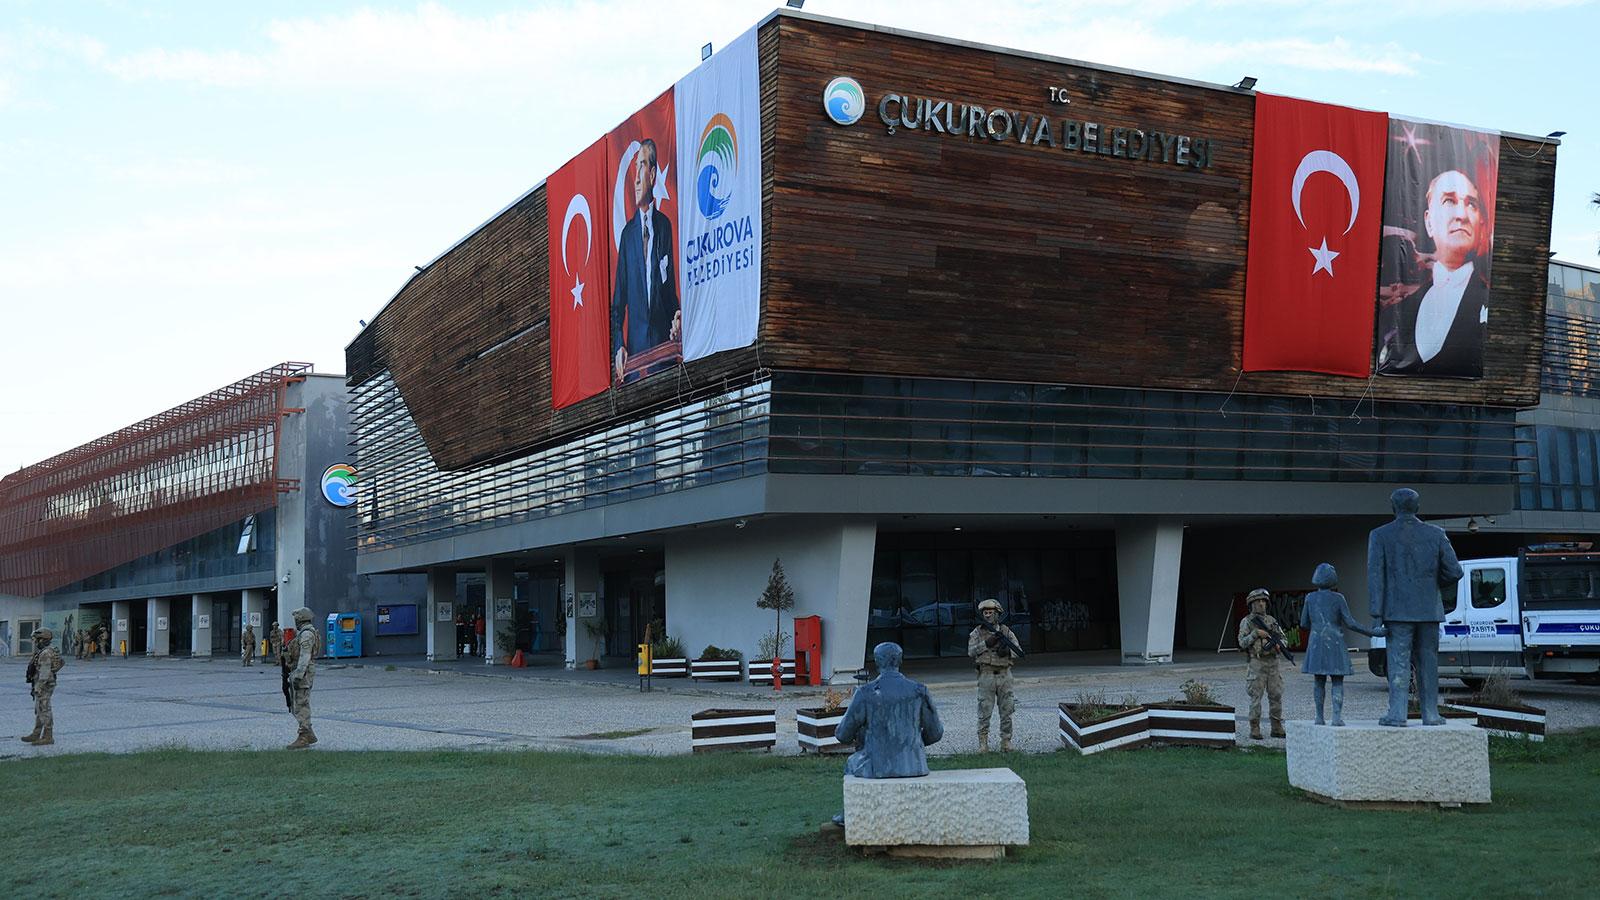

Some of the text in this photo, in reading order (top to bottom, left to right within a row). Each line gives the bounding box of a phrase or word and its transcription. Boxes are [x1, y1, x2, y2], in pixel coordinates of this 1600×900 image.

[1049, 86, 1071, 104] T.C.
[878, 93, 1214, 168] ÇUKUROVA BELEDİYESİ
